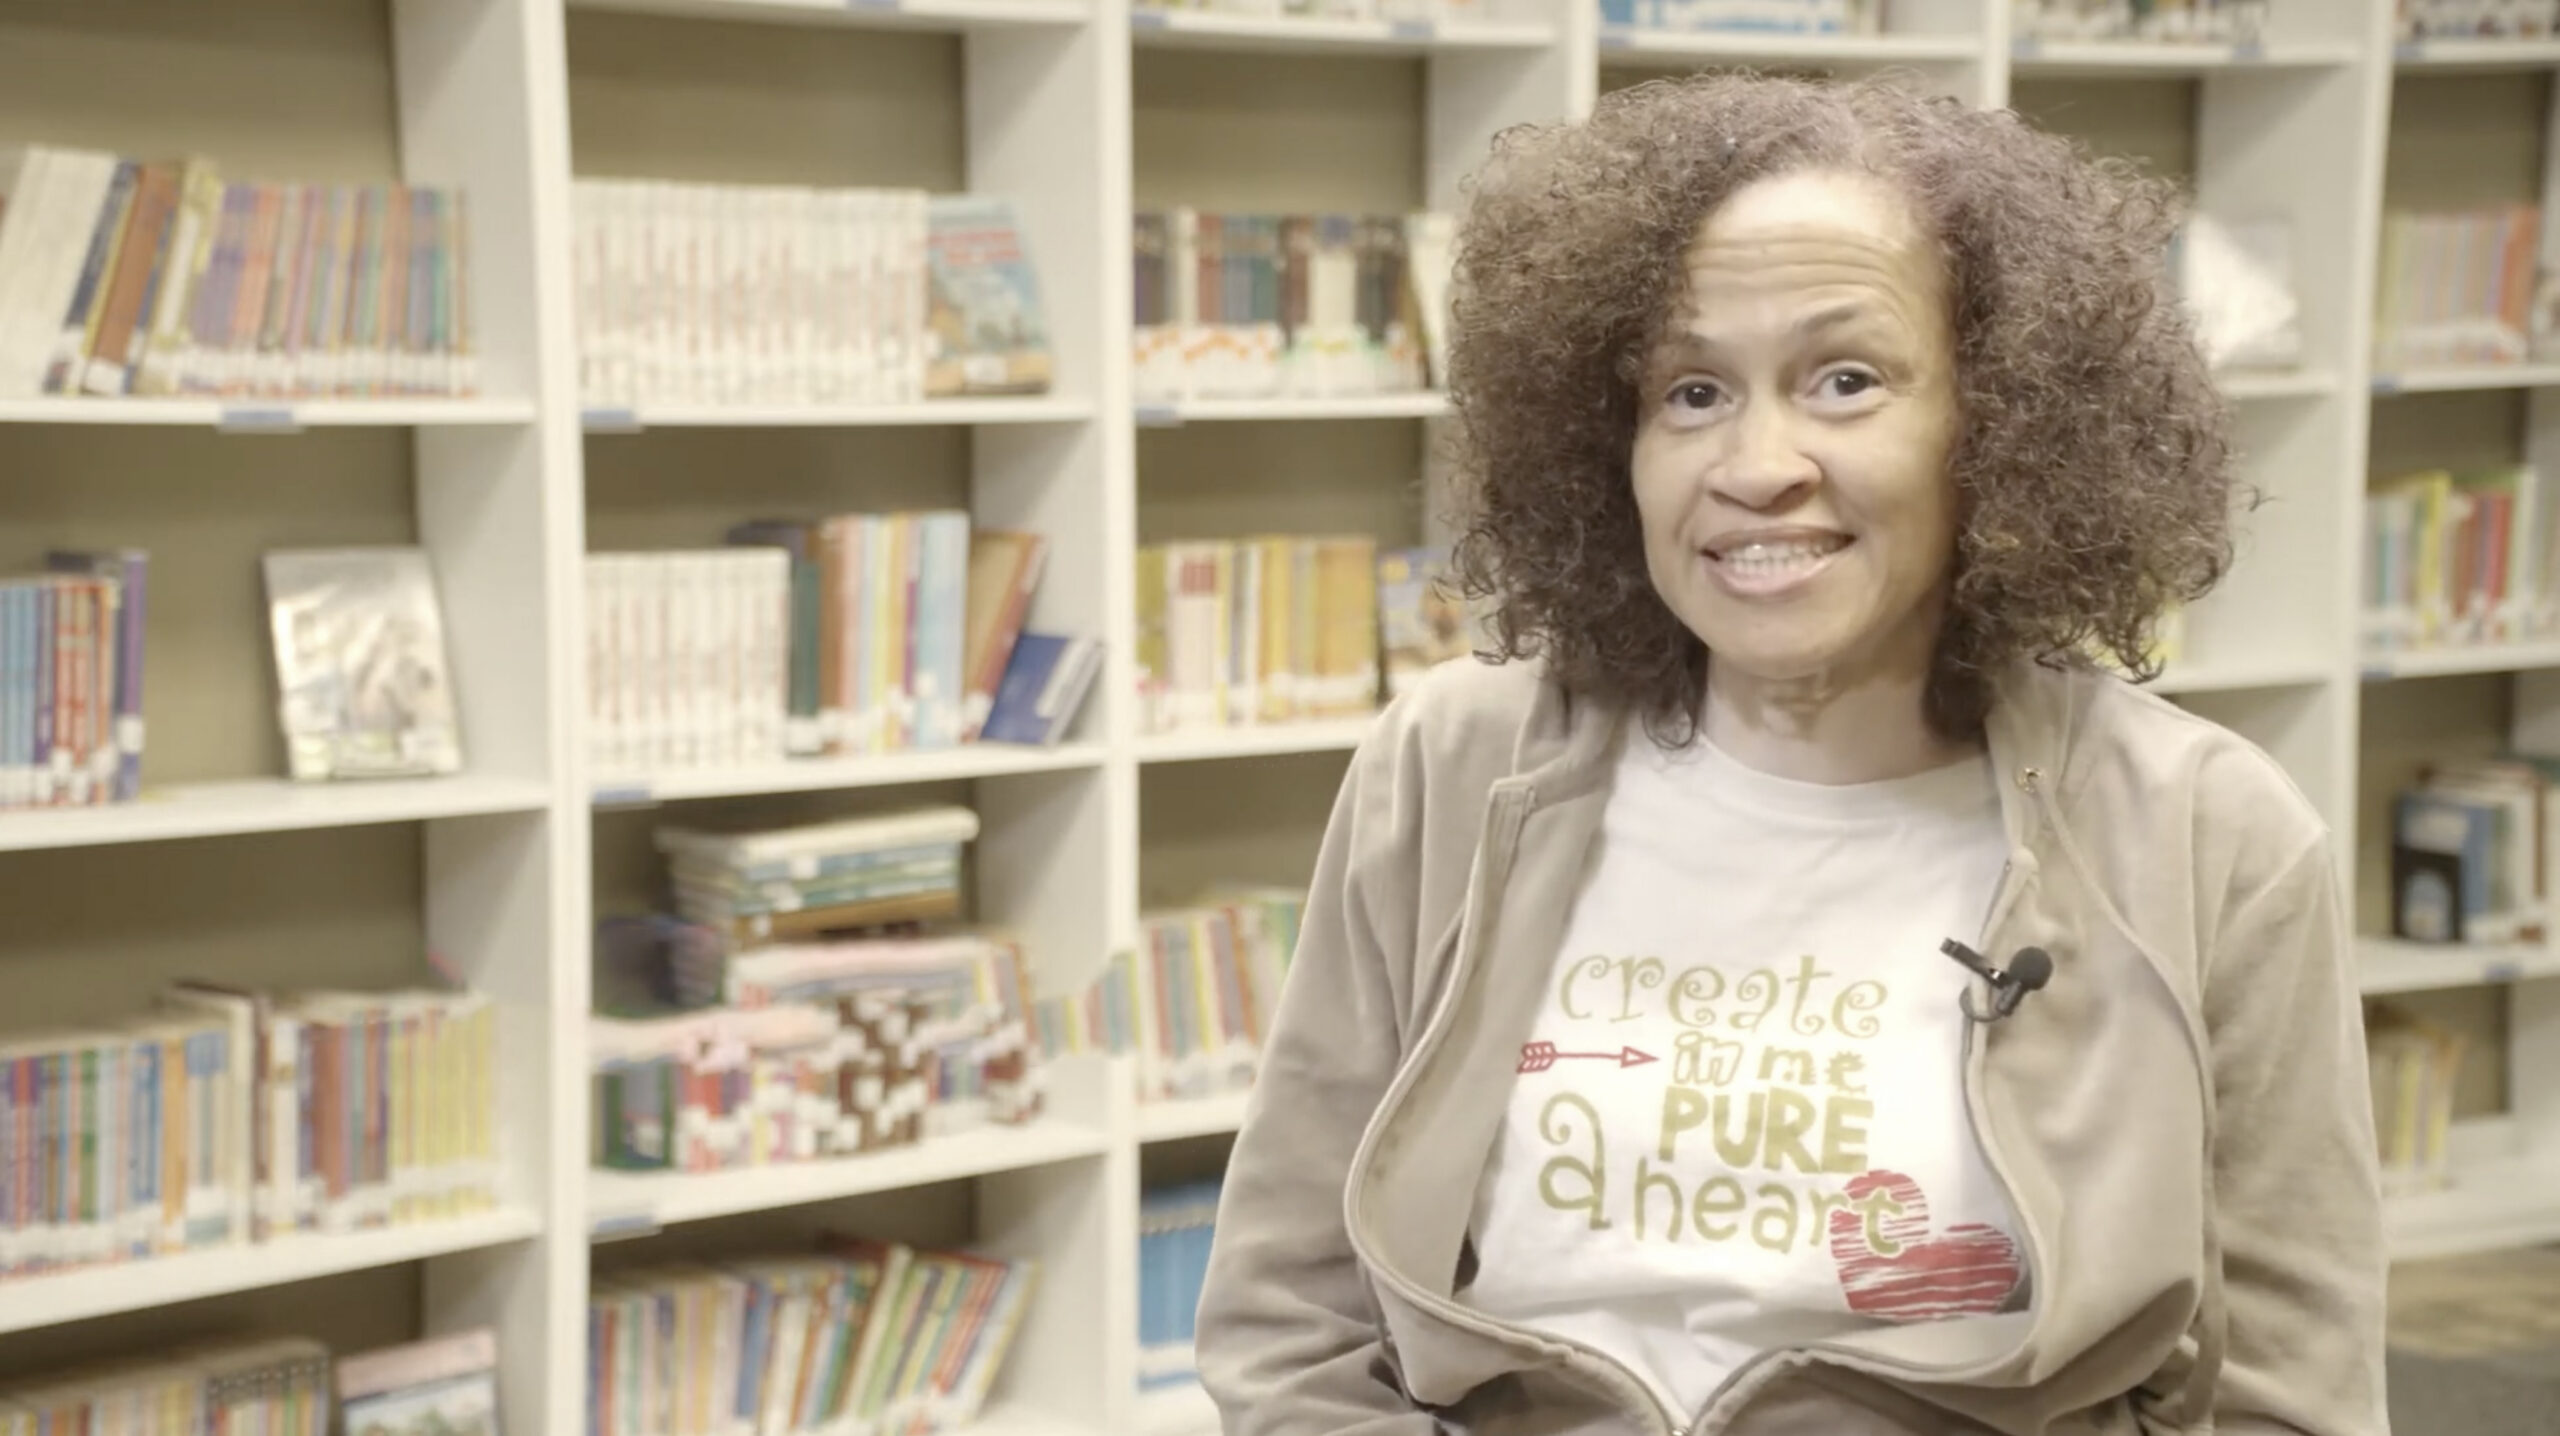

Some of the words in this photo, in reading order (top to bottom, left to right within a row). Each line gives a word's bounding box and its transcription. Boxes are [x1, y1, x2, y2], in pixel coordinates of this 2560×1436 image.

[1559, 953, 1888, 1039] create
[1673, 1031, 1744, 1086] in
[1757, 1044, 1868, 1092] me
[1538, 1091, 1611, 1231] a
[1658, 1086, 1875, 1174] PURE
[1634, 1157, 1906, 1256] heart
